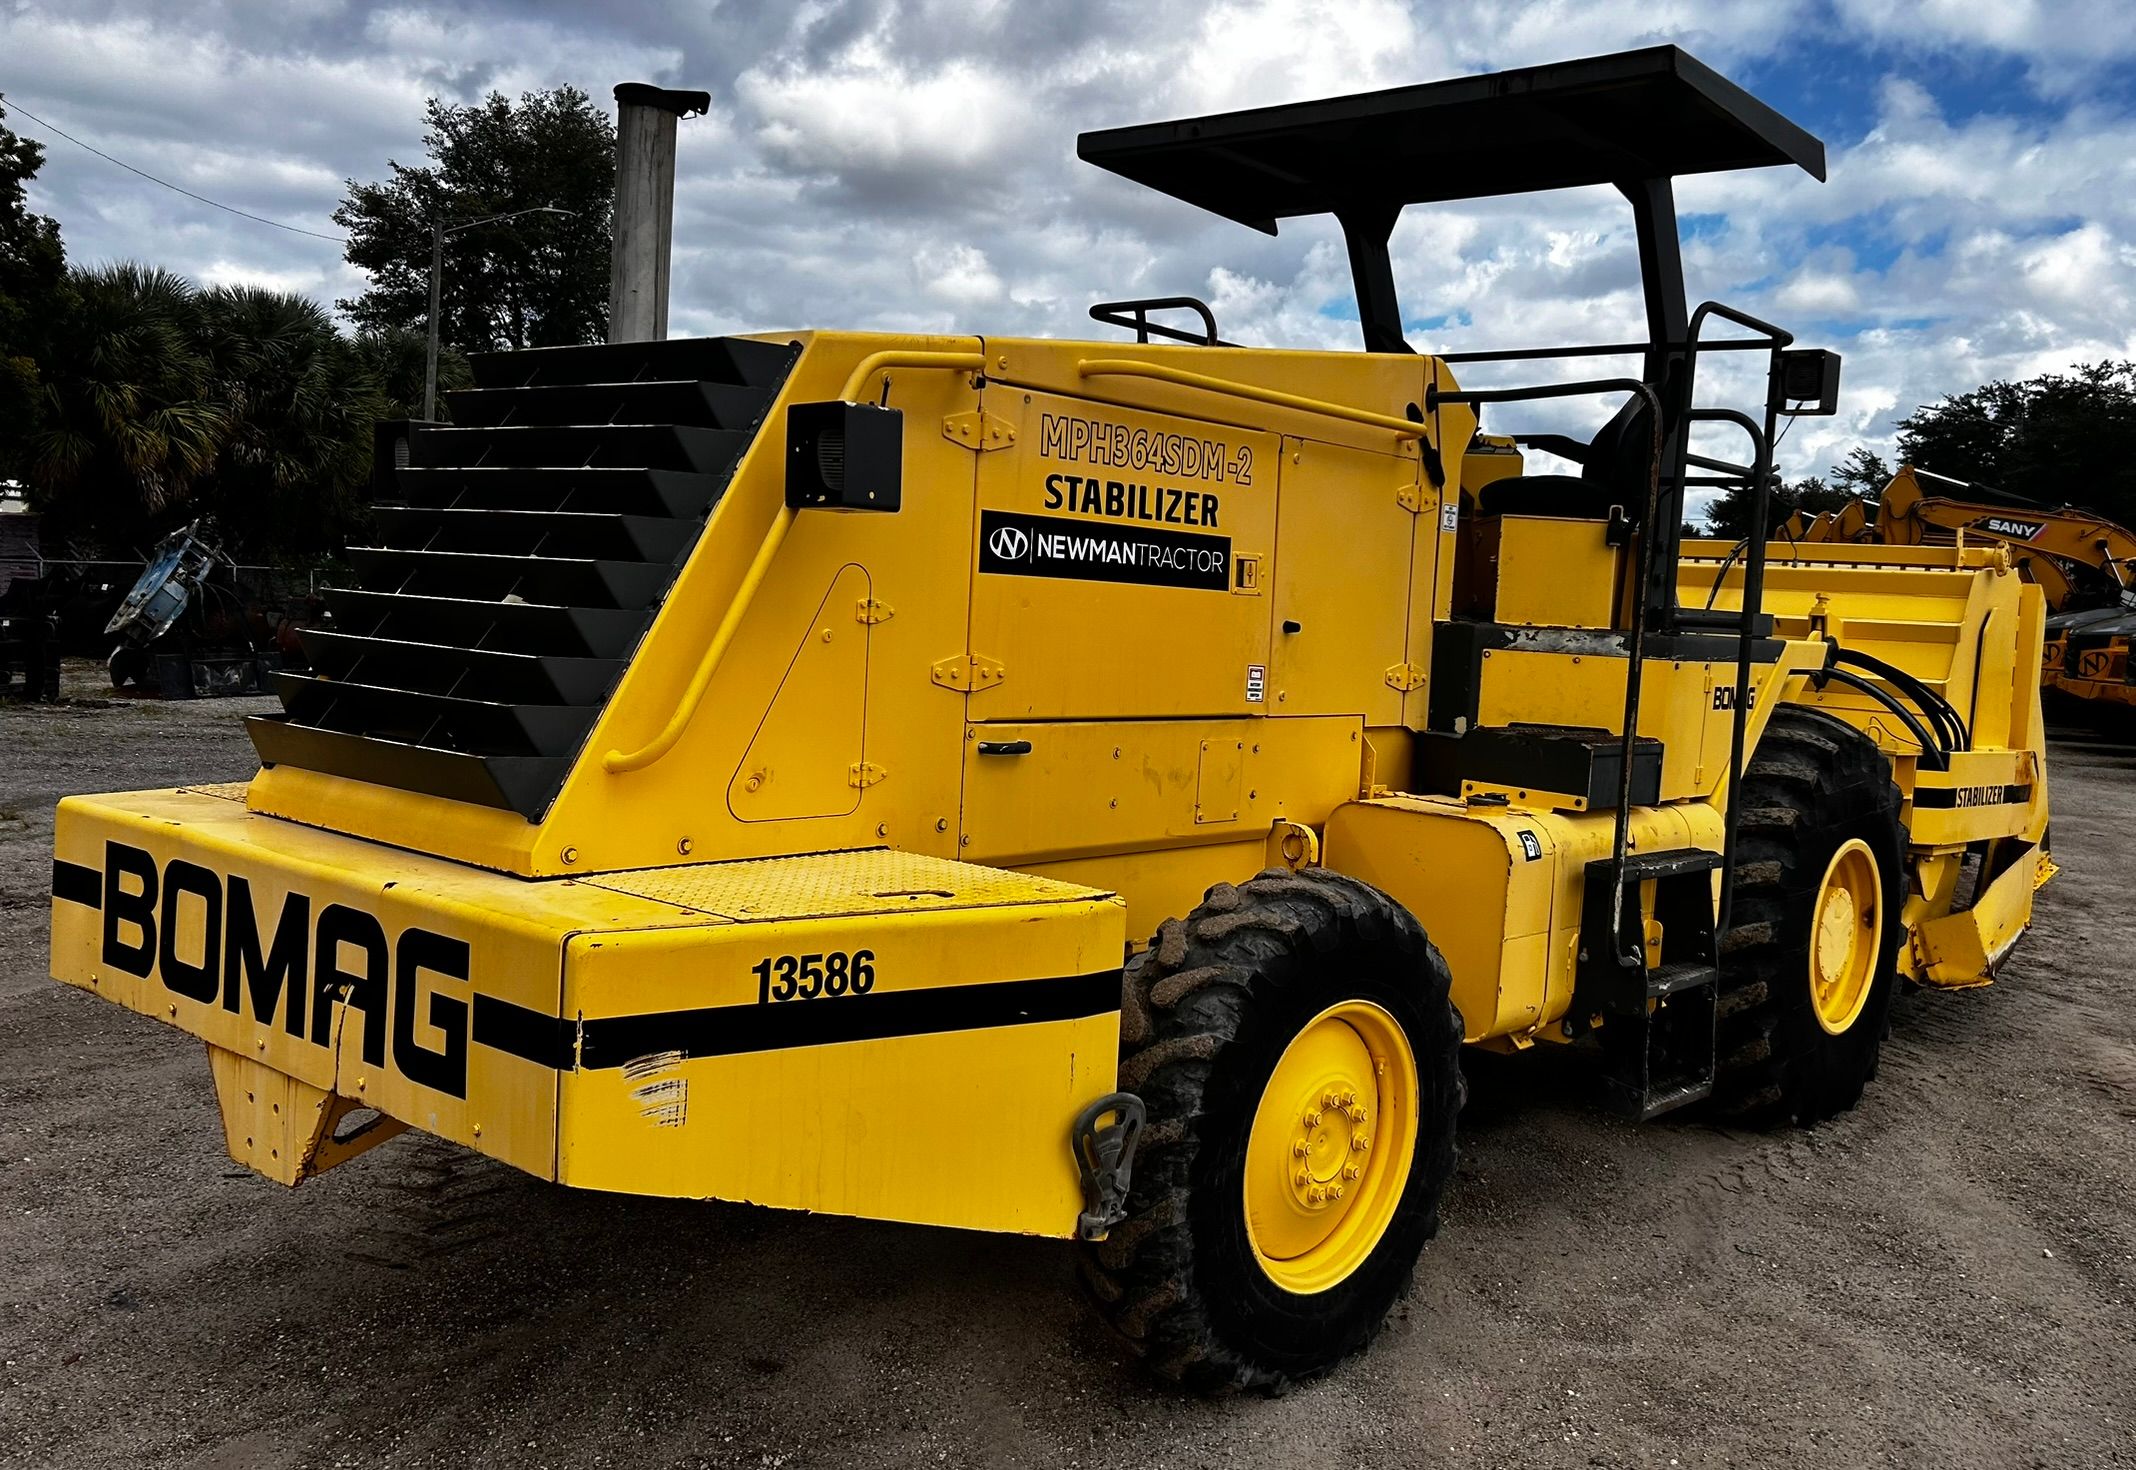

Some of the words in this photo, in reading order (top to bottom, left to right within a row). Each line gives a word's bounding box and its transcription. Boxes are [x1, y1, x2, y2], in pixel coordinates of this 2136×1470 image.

[1041, 414, 1252, 485] MPH364SDM-2
[1044, 474, 1218, 527] STABILIZER
[1988, 519, 2036, 537] SANY
[1957, 786, 2002, 807] STABILIZER
[102, 840, 471, 1101] BOMAG
[752, 949, 876, 1004] 13586
